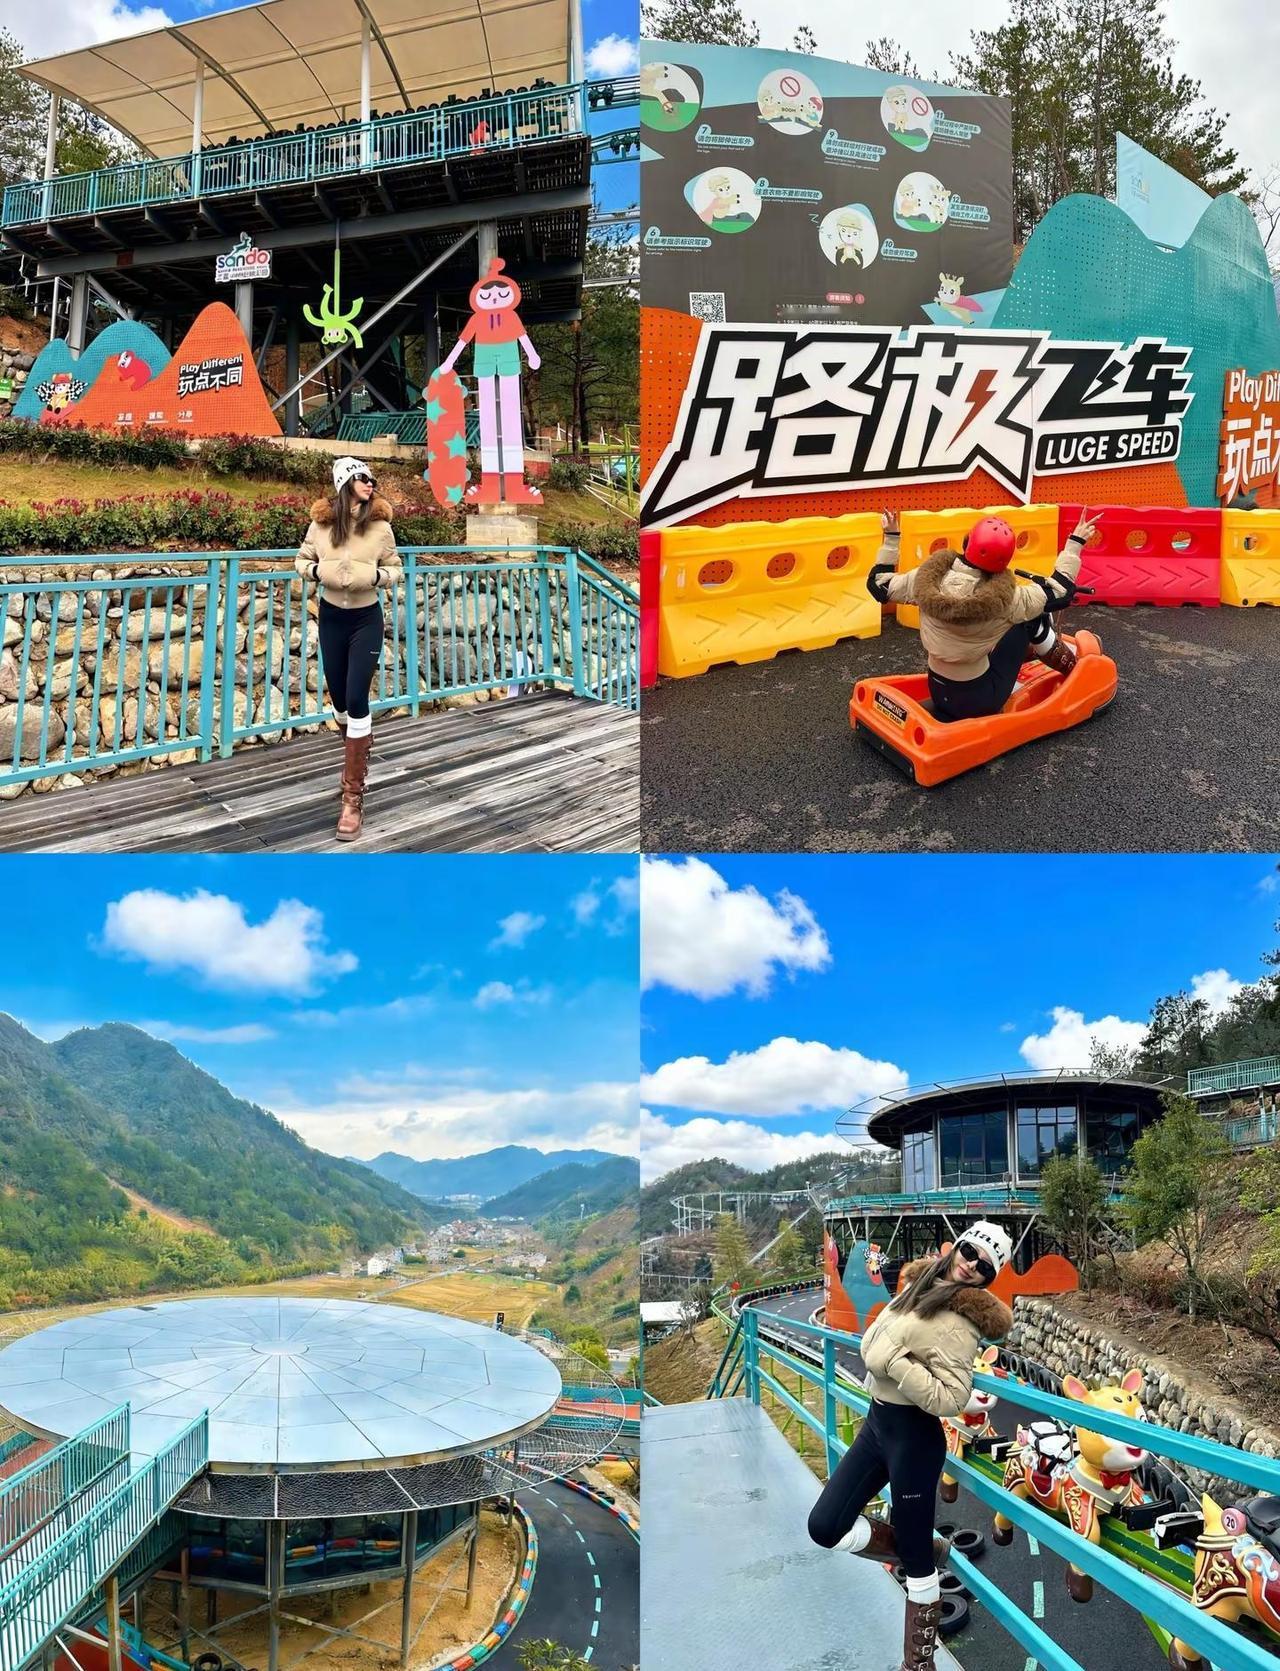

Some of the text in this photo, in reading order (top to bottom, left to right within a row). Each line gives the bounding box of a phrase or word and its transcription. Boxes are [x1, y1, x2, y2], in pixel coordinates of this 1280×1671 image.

[698, 136, 752, 145] 请勿将脚伸出车外
[755, 188, 820, 199] 注意衣物不要影响驾驶
[218, 248, 268, 268] sando
[180, 354, 243, 375] Play Different
[177, 366, 243, 397] 玩点不同
[1229, 369, 1263, 411] Play
[646, 334, 1188, 516] 路极飞车
[1044, 431, 1174, 464] LUGE SPEED
[1226, 1516, 1235, 1529] 20
